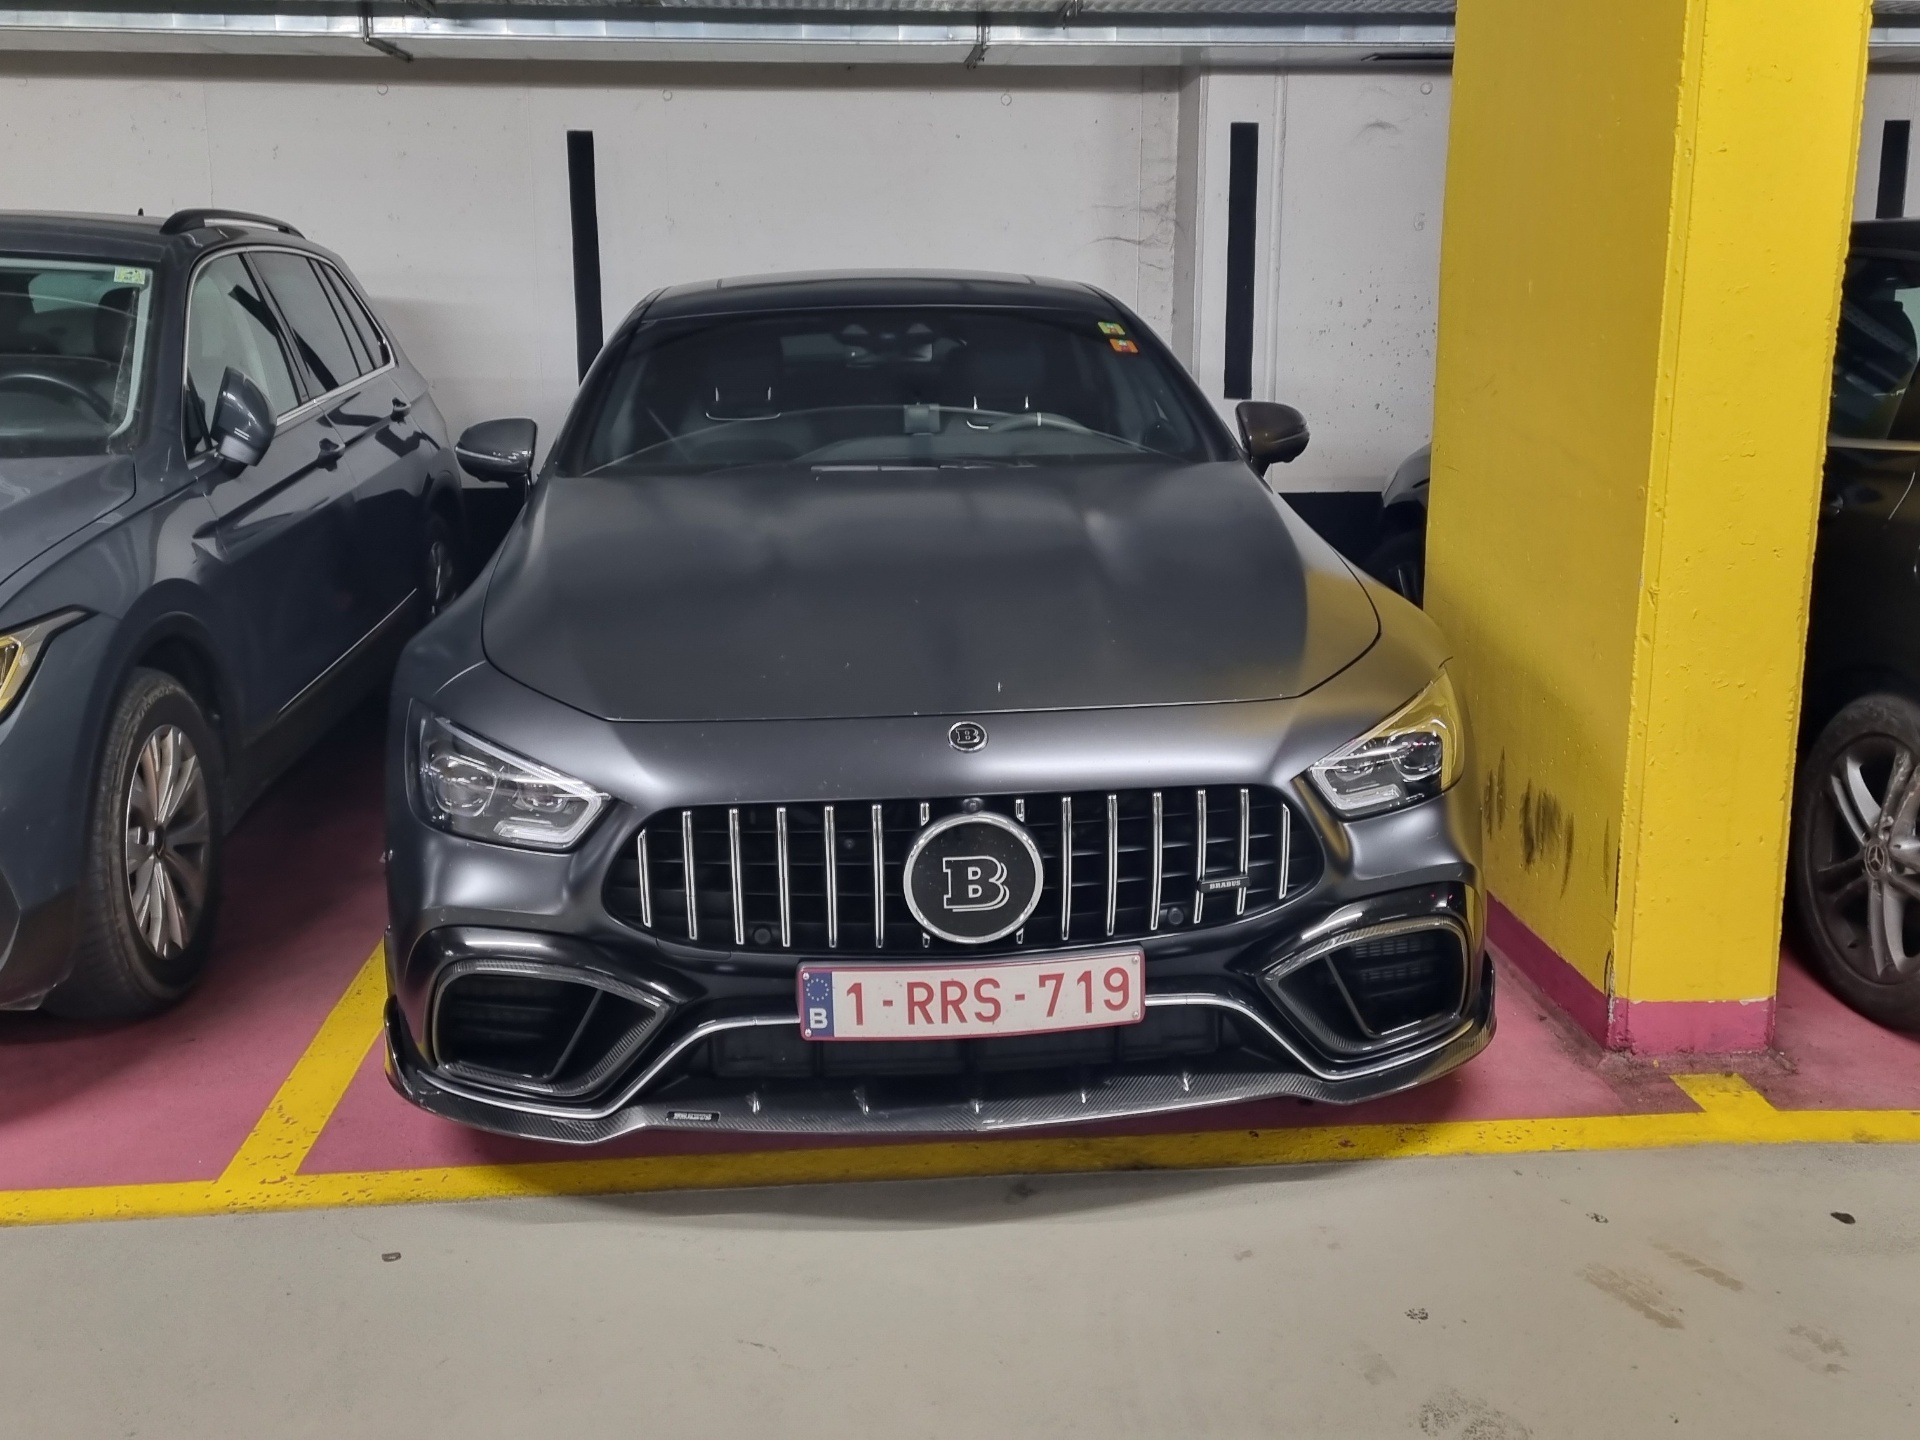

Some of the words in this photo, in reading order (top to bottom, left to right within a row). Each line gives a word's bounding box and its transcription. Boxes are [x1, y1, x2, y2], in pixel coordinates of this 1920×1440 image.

[955, 727, 980, 743] B
[942, 855, 1010, 912] B
[1209, 879, 1241, 890] BRABUS
[846, 967, 1130, 1026] 1-RRS-719
[809, 1007, 828, 1029] B
